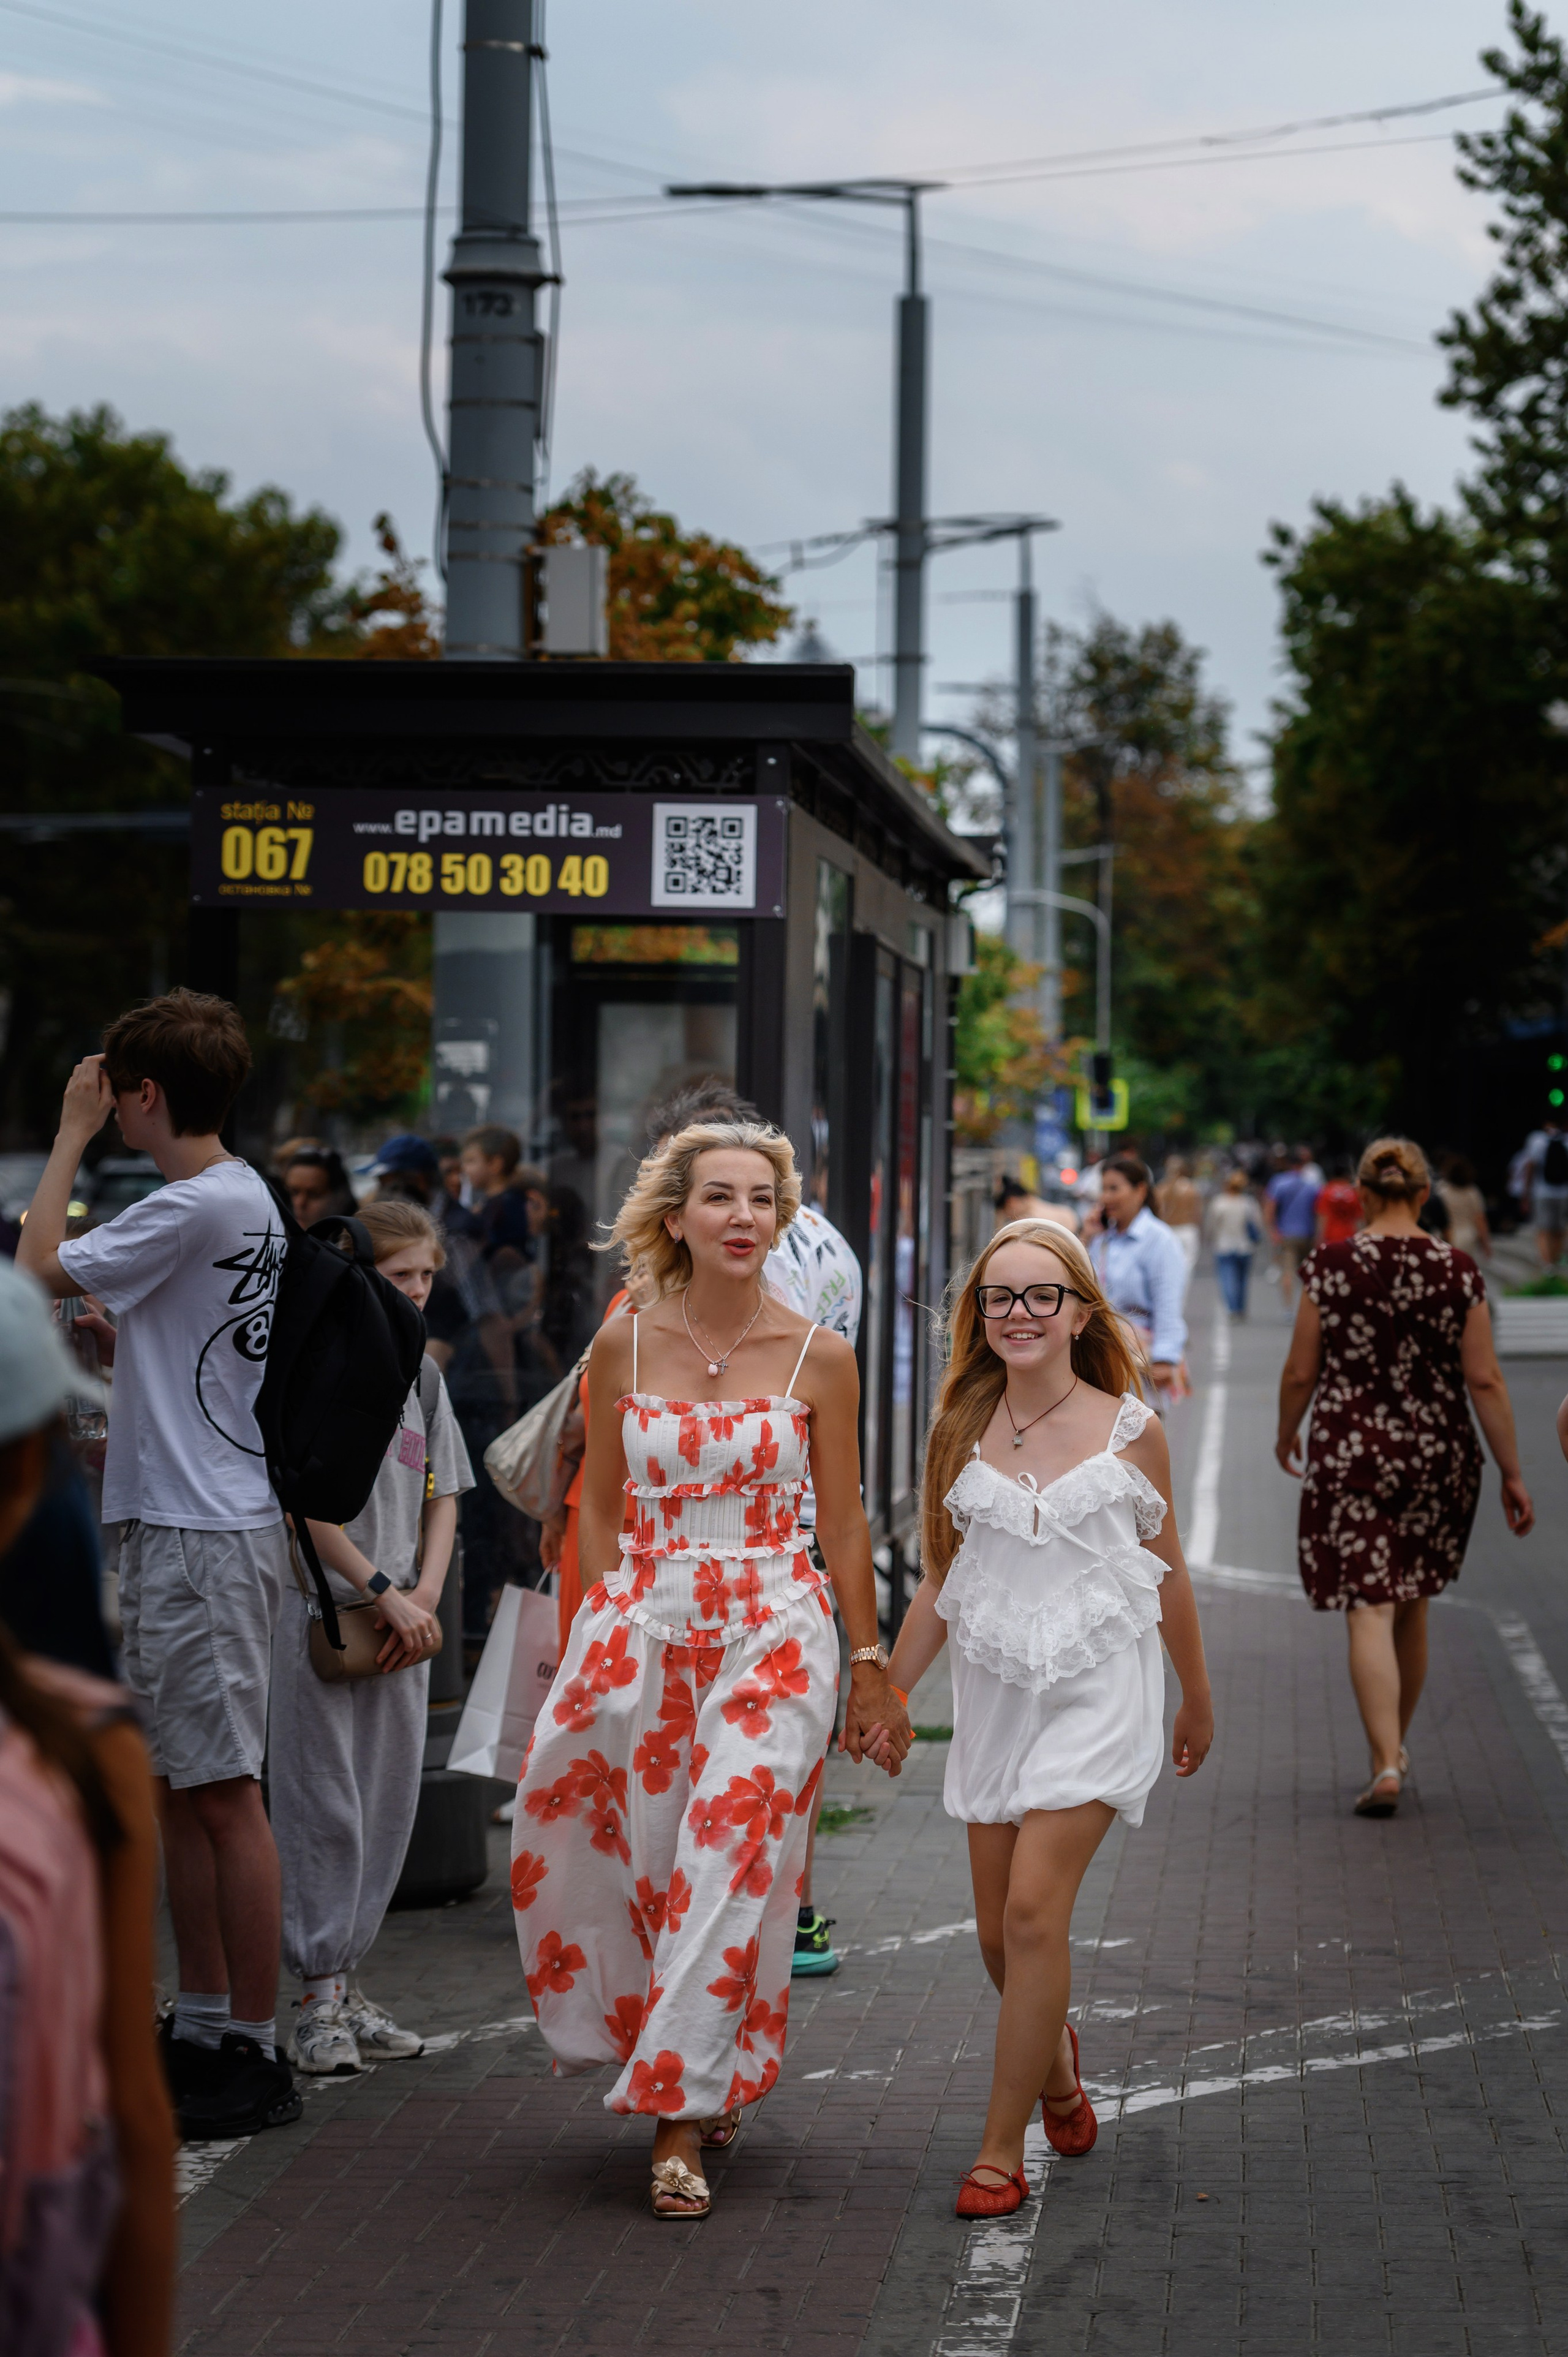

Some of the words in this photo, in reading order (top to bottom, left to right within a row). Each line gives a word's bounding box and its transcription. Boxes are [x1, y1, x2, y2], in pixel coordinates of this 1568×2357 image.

[353, 804, 622, 843] www.epamedia.md
[221, 826, 314, 880] 067
[363, 851, 432, 894] 078
[440, 853, 492, 896] 50
[499, 853, 551, 897] 30
[557, 854, 609, 898] 40
